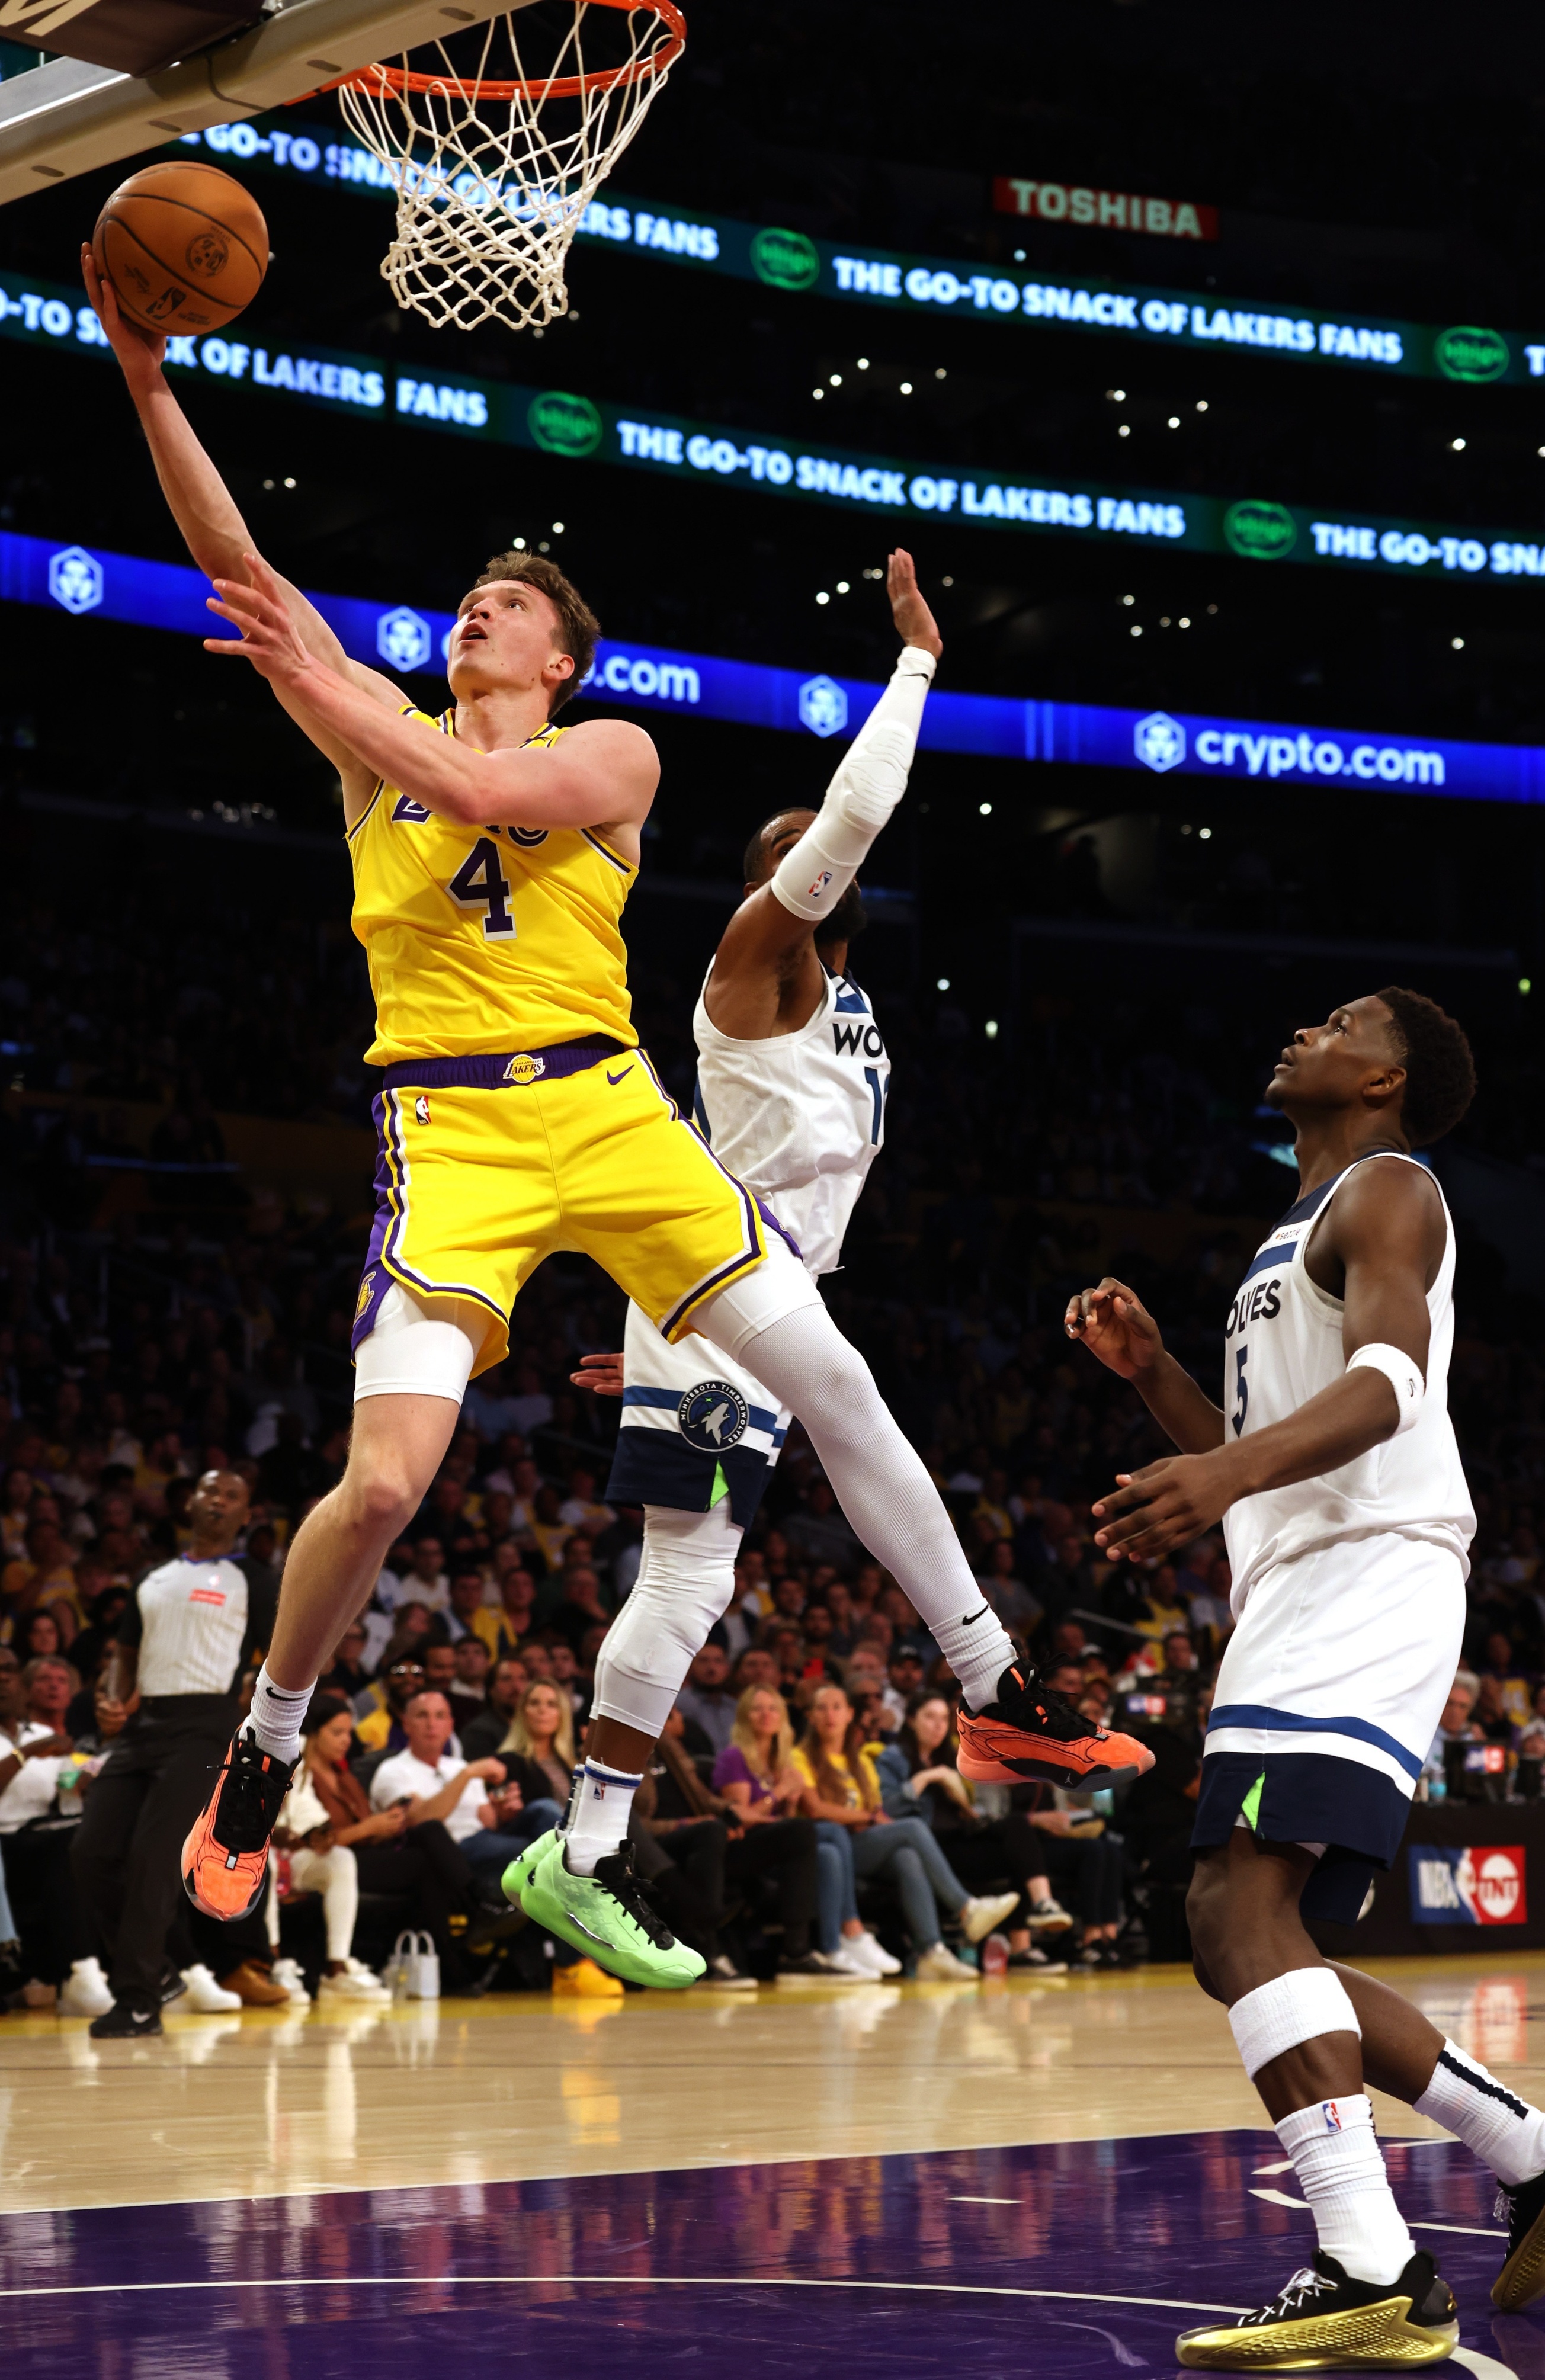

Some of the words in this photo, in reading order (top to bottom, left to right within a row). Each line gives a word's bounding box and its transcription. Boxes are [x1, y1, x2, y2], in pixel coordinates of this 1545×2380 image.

[634, 212, 719, 260] FANS
[1009, 179, 1201, 237] TOSHIBA
[832, 256, 902, 297] THE
[905, 268, 1020, 313] GO-TO
[1022, 283, 1139, 328] SNACK
[1141, 300, 1188, 334] OF
[1191, 306, 1316, 352] LAKERS
[1319, 323, 1403, 364] FANS
[201, 337, 251, 379] OF
[252, 348, 386, 408] LAKERS
[395, 378, 488, 427] FANS
[617, 420, 684, 464] THE
[686, 434, 794, 485] GO-TO
[796, 455, 907, 506] SNACK
[909, 476, 958, 511] OF
[961, 482, 1093, 528] LAKERS
[1097, 497, 1185, 538] FANS
[1310, 522, 1377, 560] THE
[1379, 530, 1487, 572] GO-TO
[1195, 730, 1445, 786] crypto.com
[445, 834, 517, 942] 4
[507, 1063, 543, 1077] LAKERS
[864, 1066, 889, 1146] 1
[681, 1383, 717, 1420] MINNESOTA
[720, 1384, 747, 1444] TIMBERWOLVES
[1232, 1344, 1248, 1438] 5
